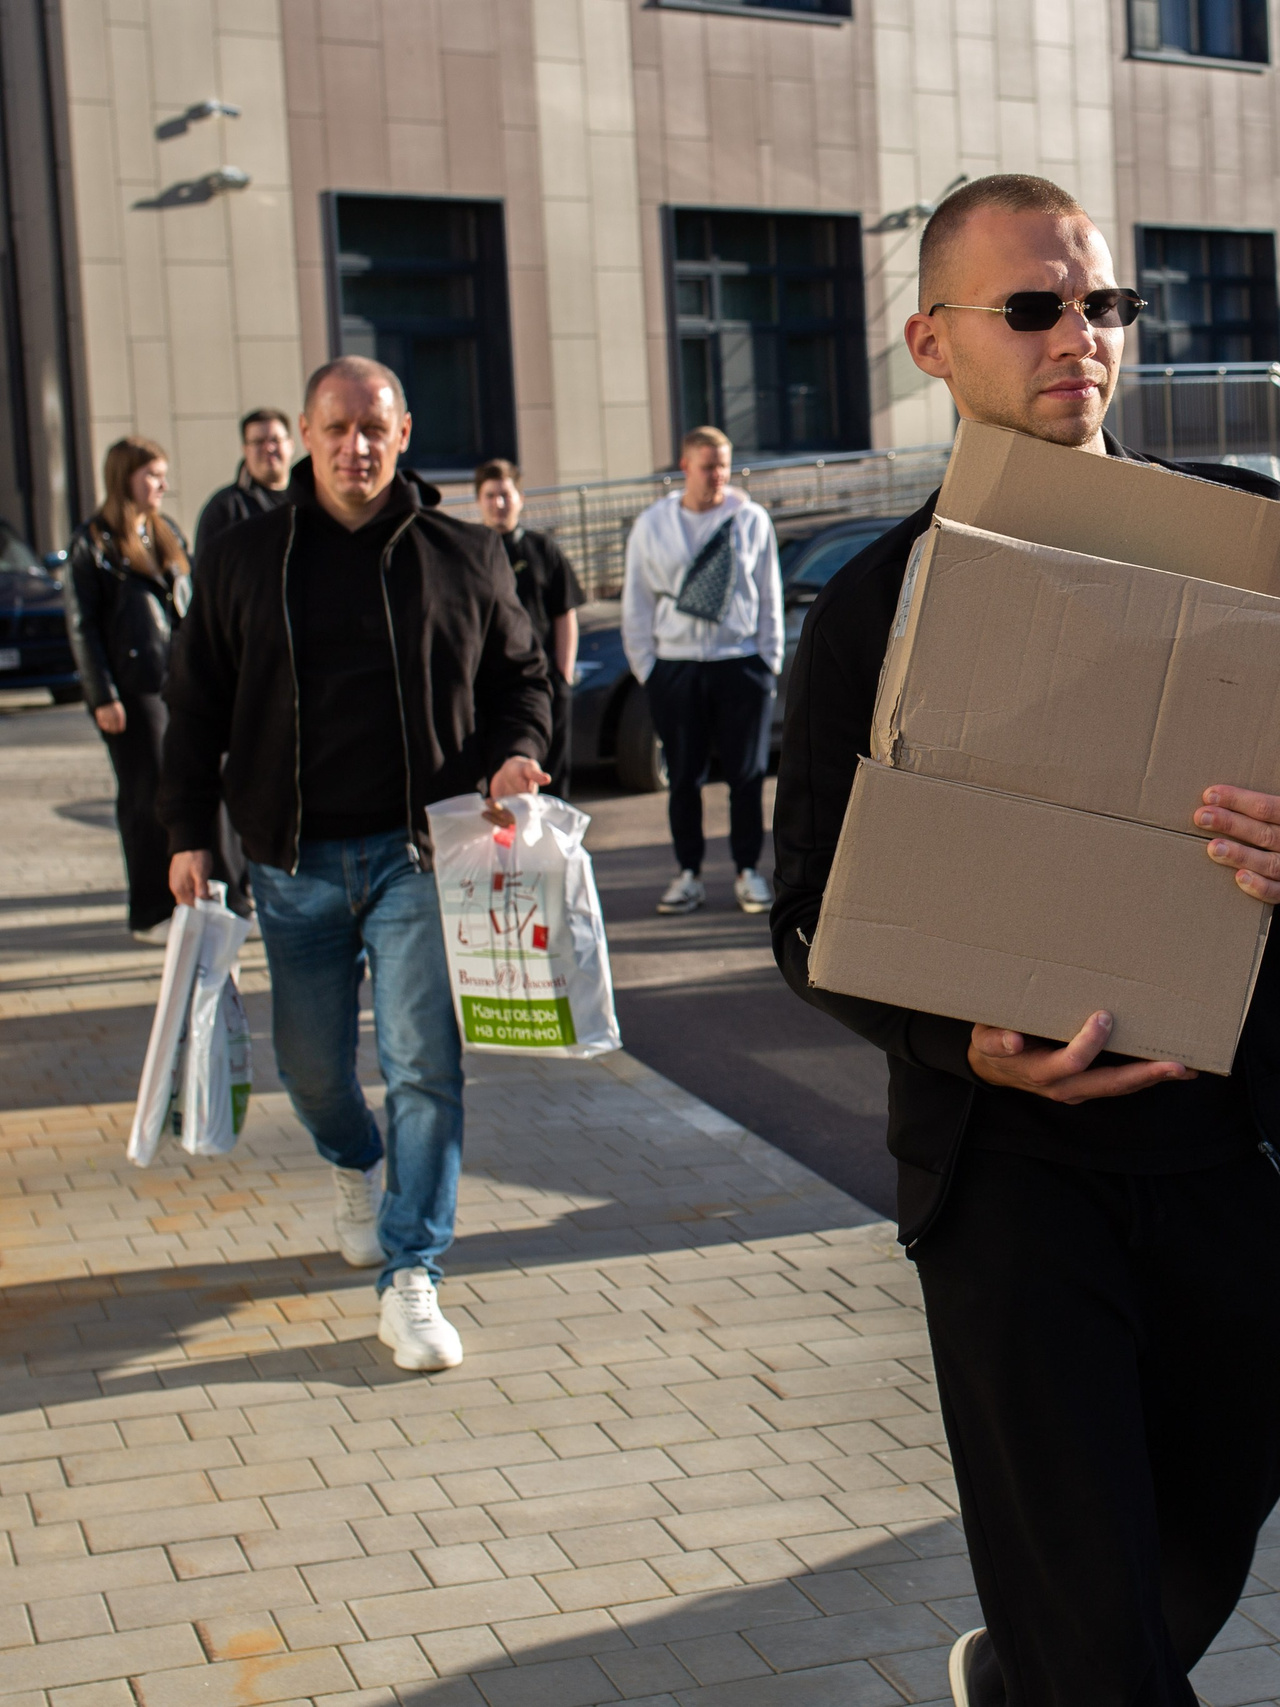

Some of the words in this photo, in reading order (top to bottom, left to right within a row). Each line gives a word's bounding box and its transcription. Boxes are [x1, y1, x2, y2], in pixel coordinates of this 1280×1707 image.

[471, 1002, 560, 1025] Канцтовары
[474, 1024, 494, 1038] на
[496, 1024, 564, 1041] отлично!
